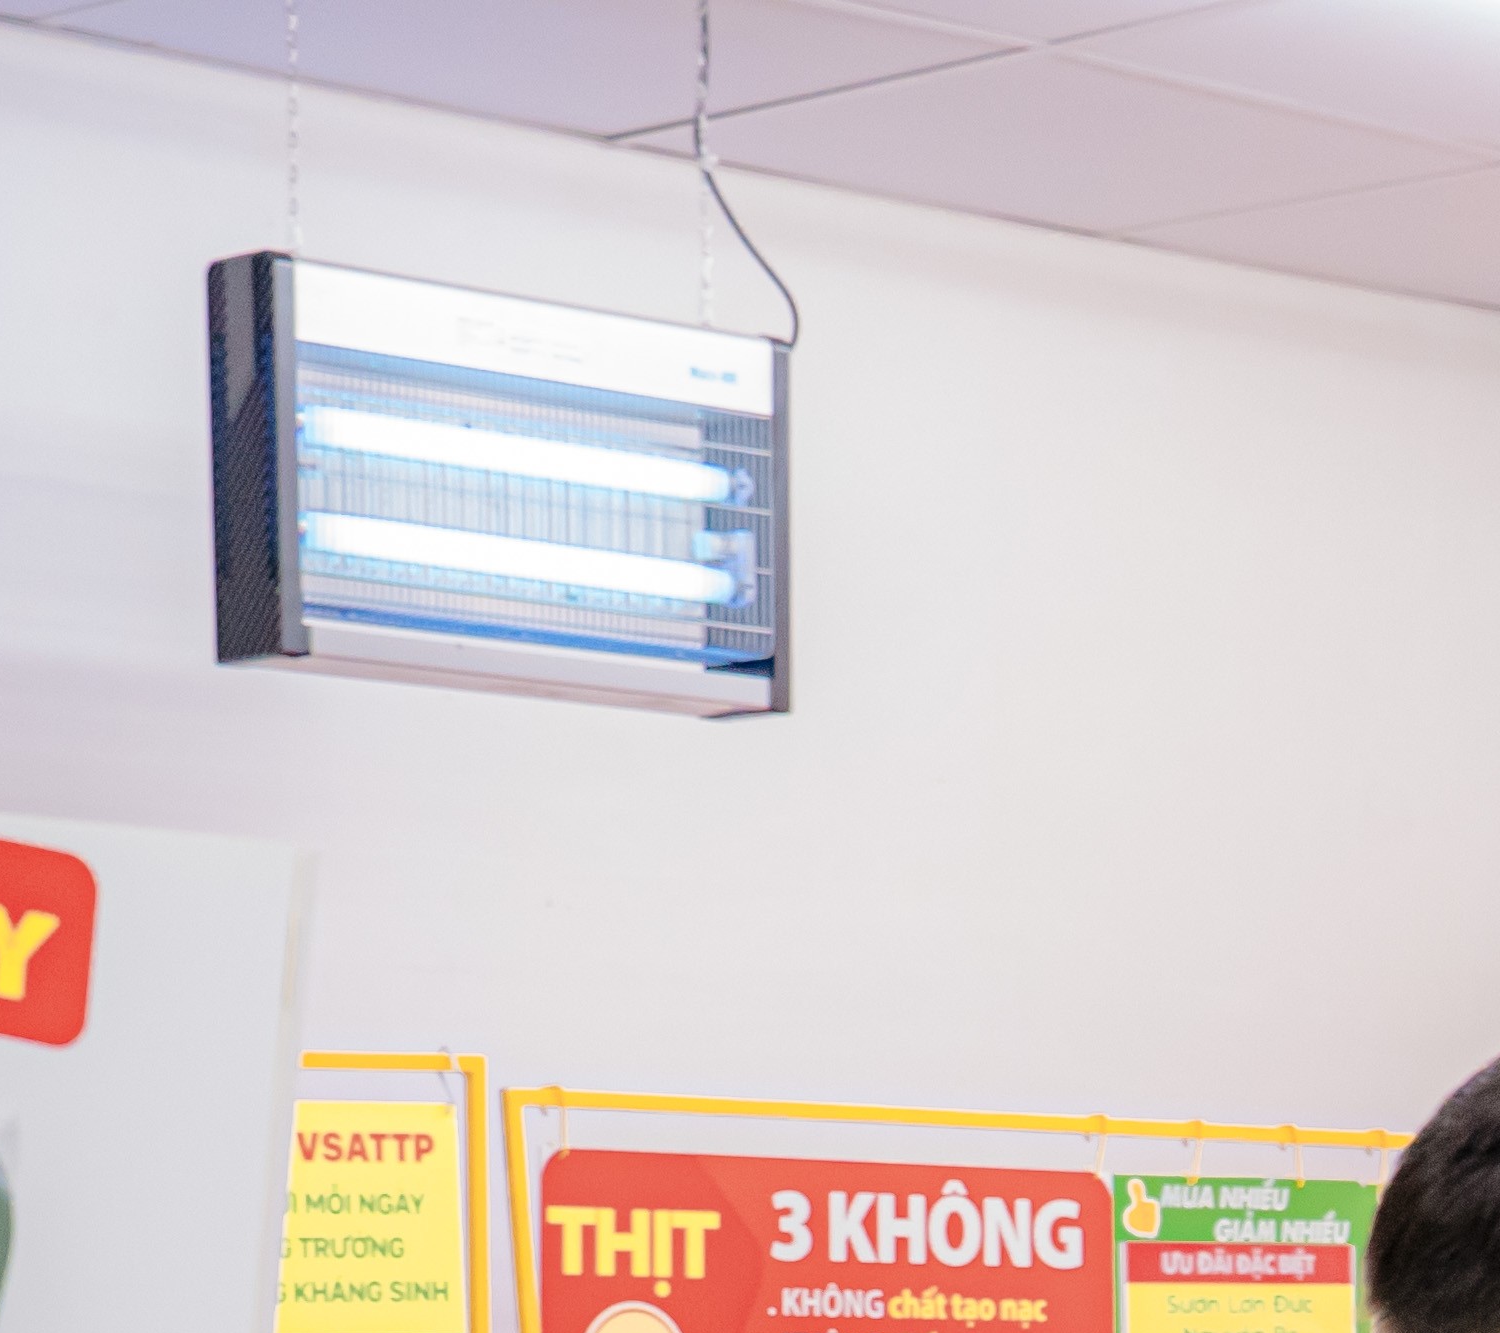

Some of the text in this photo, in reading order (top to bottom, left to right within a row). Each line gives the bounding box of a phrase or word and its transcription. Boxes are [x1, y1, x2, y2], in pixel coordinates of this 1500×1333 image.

[296, 1131, 435, 1163] VSATTP
[1159, 1184, 1213, 1210] MUA
[769, 1178, 1084, 1270] 3 KHÔNG
[545, 1205, 721, 1298] THỊT
[389, 1280, 450, 1303] SINH
[887, 1286, 948, 1320] chất
[951, 1293, 997, 1328] tạo
[1000, 1298, 1048, 1329] nạc
